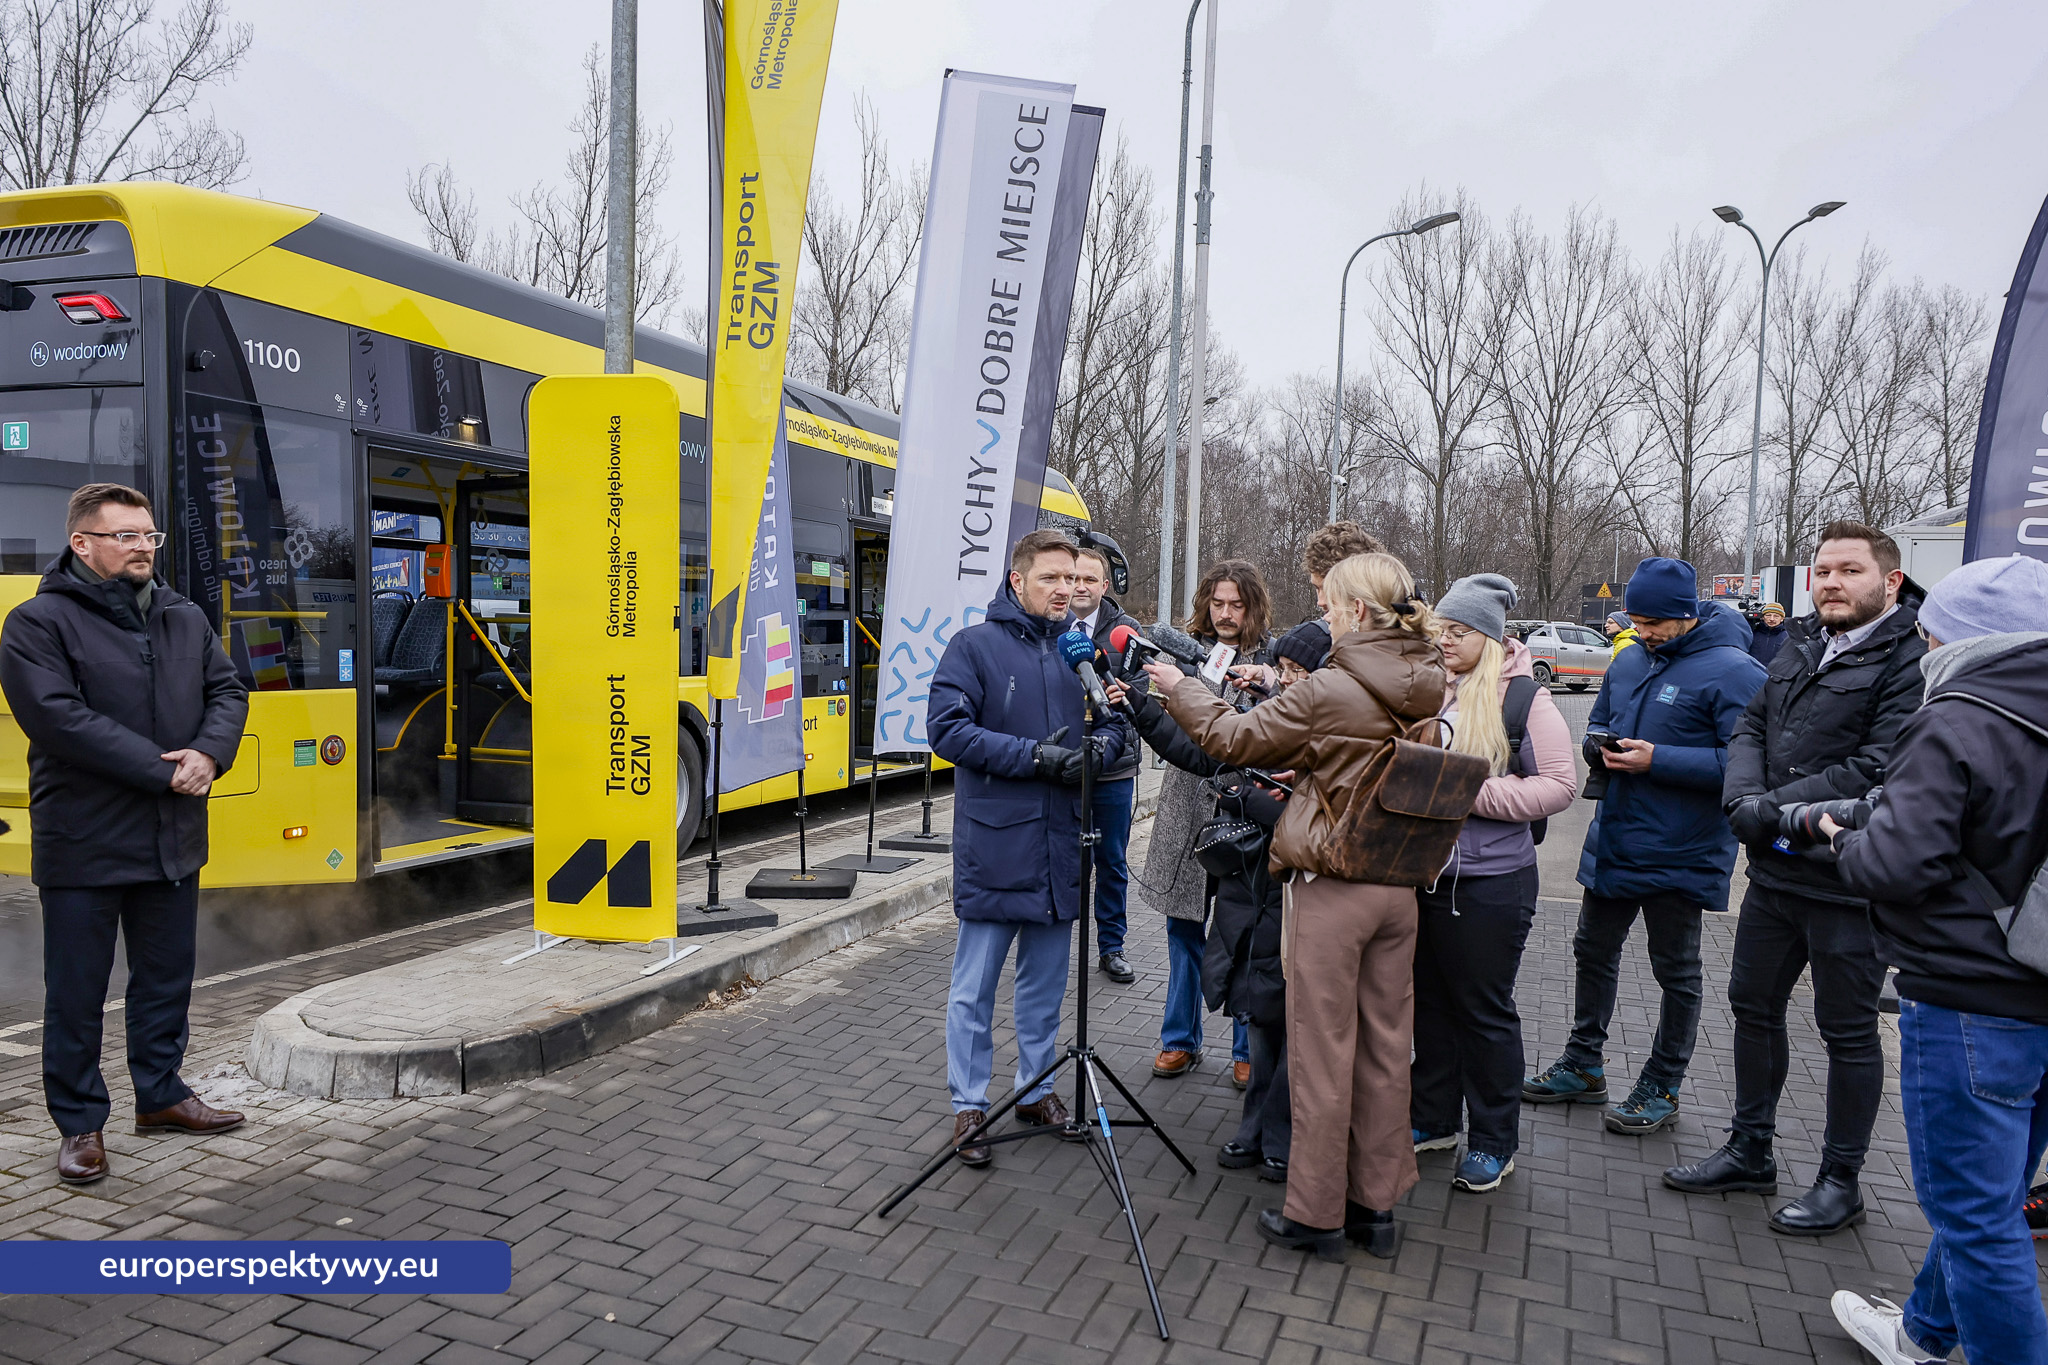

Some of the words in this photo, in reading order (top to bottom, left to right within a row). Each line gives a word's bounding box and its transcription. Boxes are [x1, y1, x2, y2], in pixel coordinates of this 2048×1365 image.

[750, 0, 783, 89] Górnośląs
[996, 103, 1049, 263] MIEJSCE
[725, 171, 759, 350] Transport
[747, 261, 781, 350] GZM
[975, 278, 1021, 415] DOBRE
[53, 341, 128, 361] wodorowy
[243, 339, 301, 373] 1100
[679, 440, 706, 464] owy
[785, 418, 887, 457] rnośląsko-Zagłębiowska
[605, 415, 622, 638] Górnośląsko-Zagłębiowska
[957, 455, 997, 581] TYCHY
[621, 551, 639, 638] Metropolia
[1071, 646, 1091, 657] news
[605, 673, 631, 796] Transport
[630, 735, 651, 796] GZM
[803, 715, 818, 731] ort
